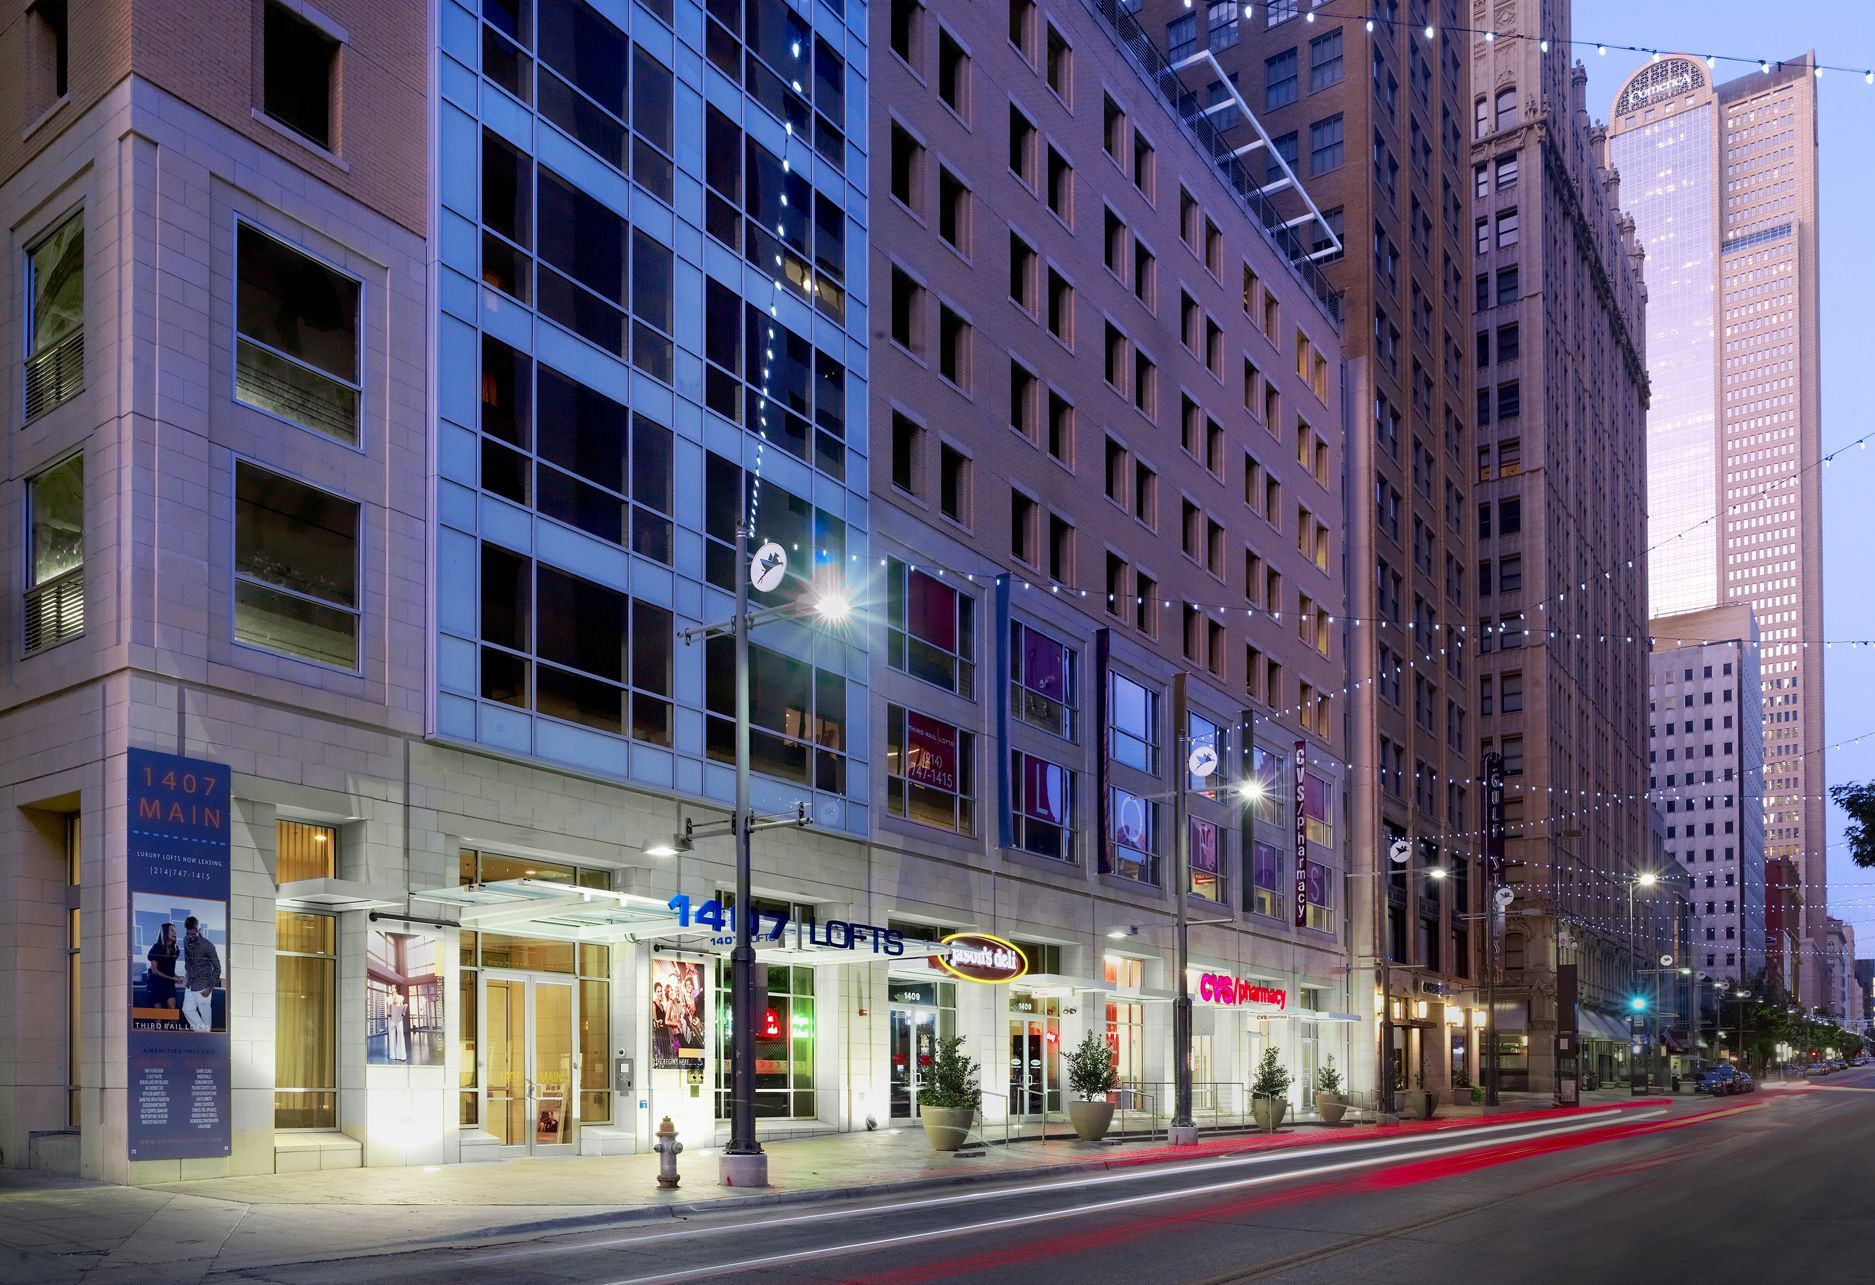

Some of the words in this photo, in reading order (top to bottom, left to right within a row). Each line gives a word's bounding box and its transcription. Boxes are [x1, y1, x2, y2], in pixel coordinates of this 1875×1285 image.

[922, 751, 943, 769] (214)
[143, 767, 216, 796] 1407
[139, 797, 221, 829] MAIN
[1296, 748, 1306, 918] CVS/pharmacy
[137, 851, 161, 860] LUXURY
[162, 854, 181, 862] LOFTS
[198, 859, 222, 867] LEASING
[150, 866, 210, 881] (214)747-1415
[710, 935, 736, 946] 140
[809, 911, 905, 957] LOFTS
[950, 941, 992, 967] jason's
[994, 949, 1016, 969] deli
[904, 991, 920, 1001] 1409
[1200, 973, 1286, 1010] CVS/pharmacy
[1019, 1002, 1032, 1011] 1409
[136, 1022, 162, 1030] THIRD
[164, 1022, 184, 1031] RAIL
